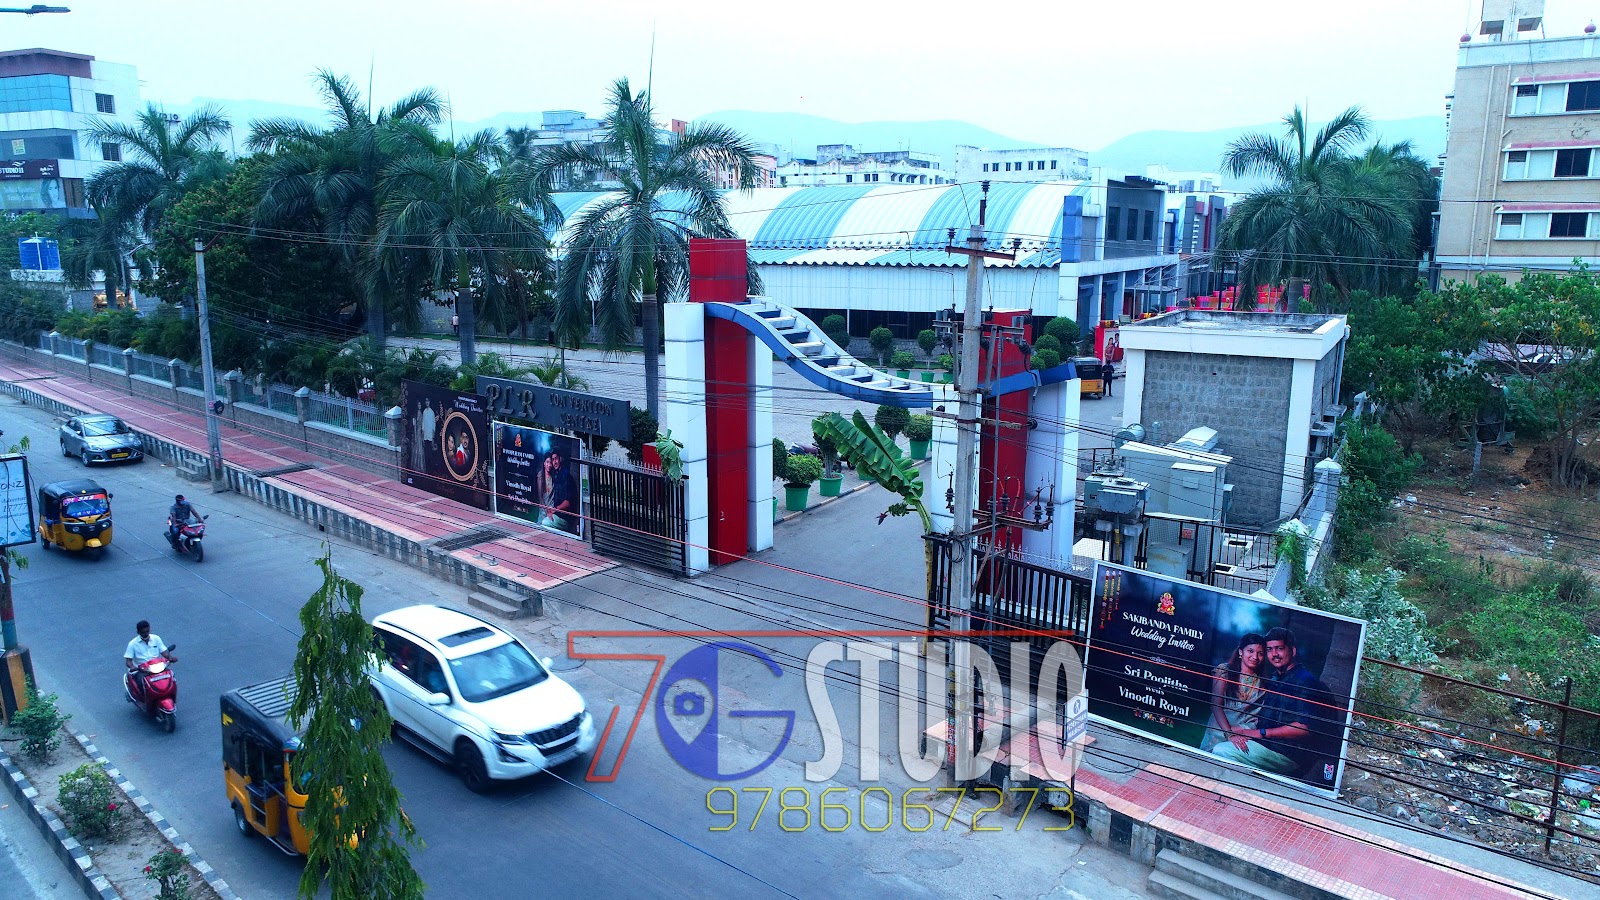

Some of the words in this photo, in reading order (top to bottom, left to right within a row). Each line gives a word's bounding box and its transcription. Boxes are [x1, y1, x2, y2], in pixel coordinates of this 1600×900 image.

[1122, 611, 1171, 632] SAKIBANDA
[1173, 624, 1205, 640] FAMILY
[1130, 625, 1167, 649] Wedding
[1167, 634, 1195, 651] Invites
[1124, 664, 1141, 678] Sri
[1118, 685, 1157, 707] Vinodh
[1159, 697, 1190, 717] Royal
